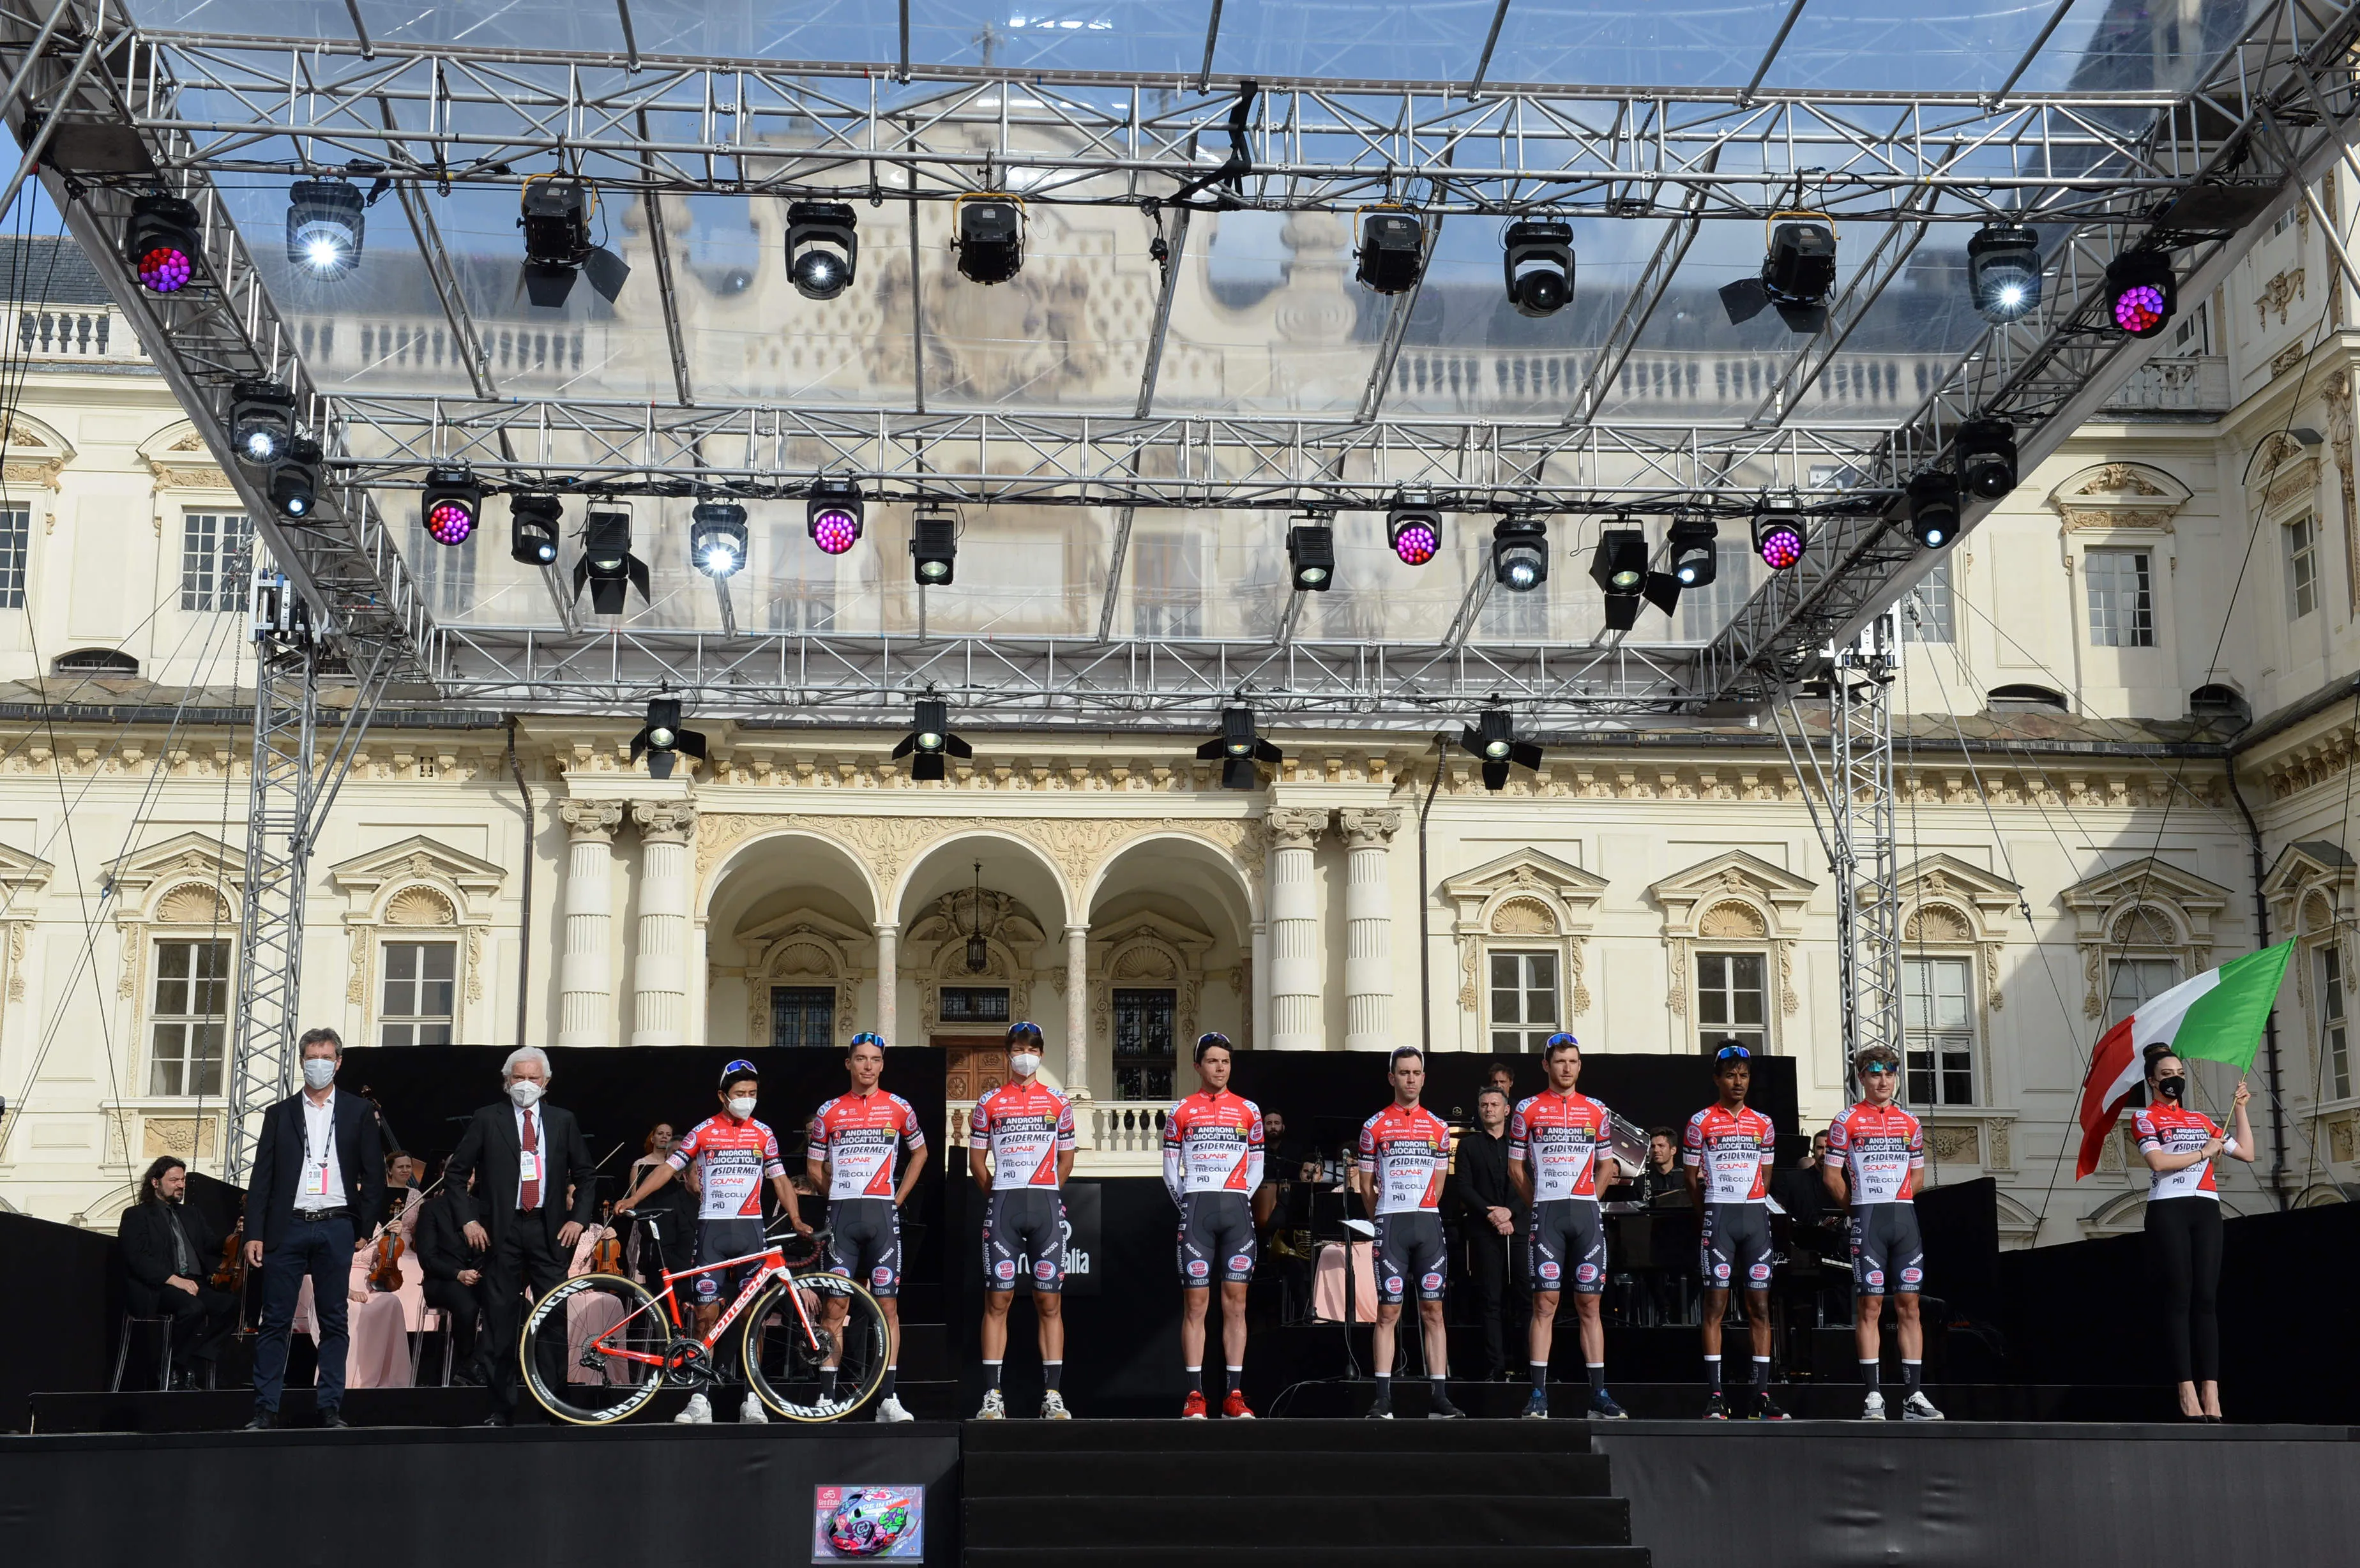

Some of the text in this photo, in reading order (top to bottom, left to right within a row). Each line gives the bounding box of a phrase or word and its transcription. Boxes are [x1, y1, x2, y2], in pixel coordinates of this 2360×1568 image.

[1002, 1124, 1047, 1133] GIOCATTOLI
[1001, 1145, 1035, 1154] GOLMAR
[530, 1279, 594, 1335] MICHE
[708, 1267, 771, 1341] BOTTECCHIA
[591, 1370, 658, 1421] MICHE
[778, 1398, 854, 1417] MICHE
